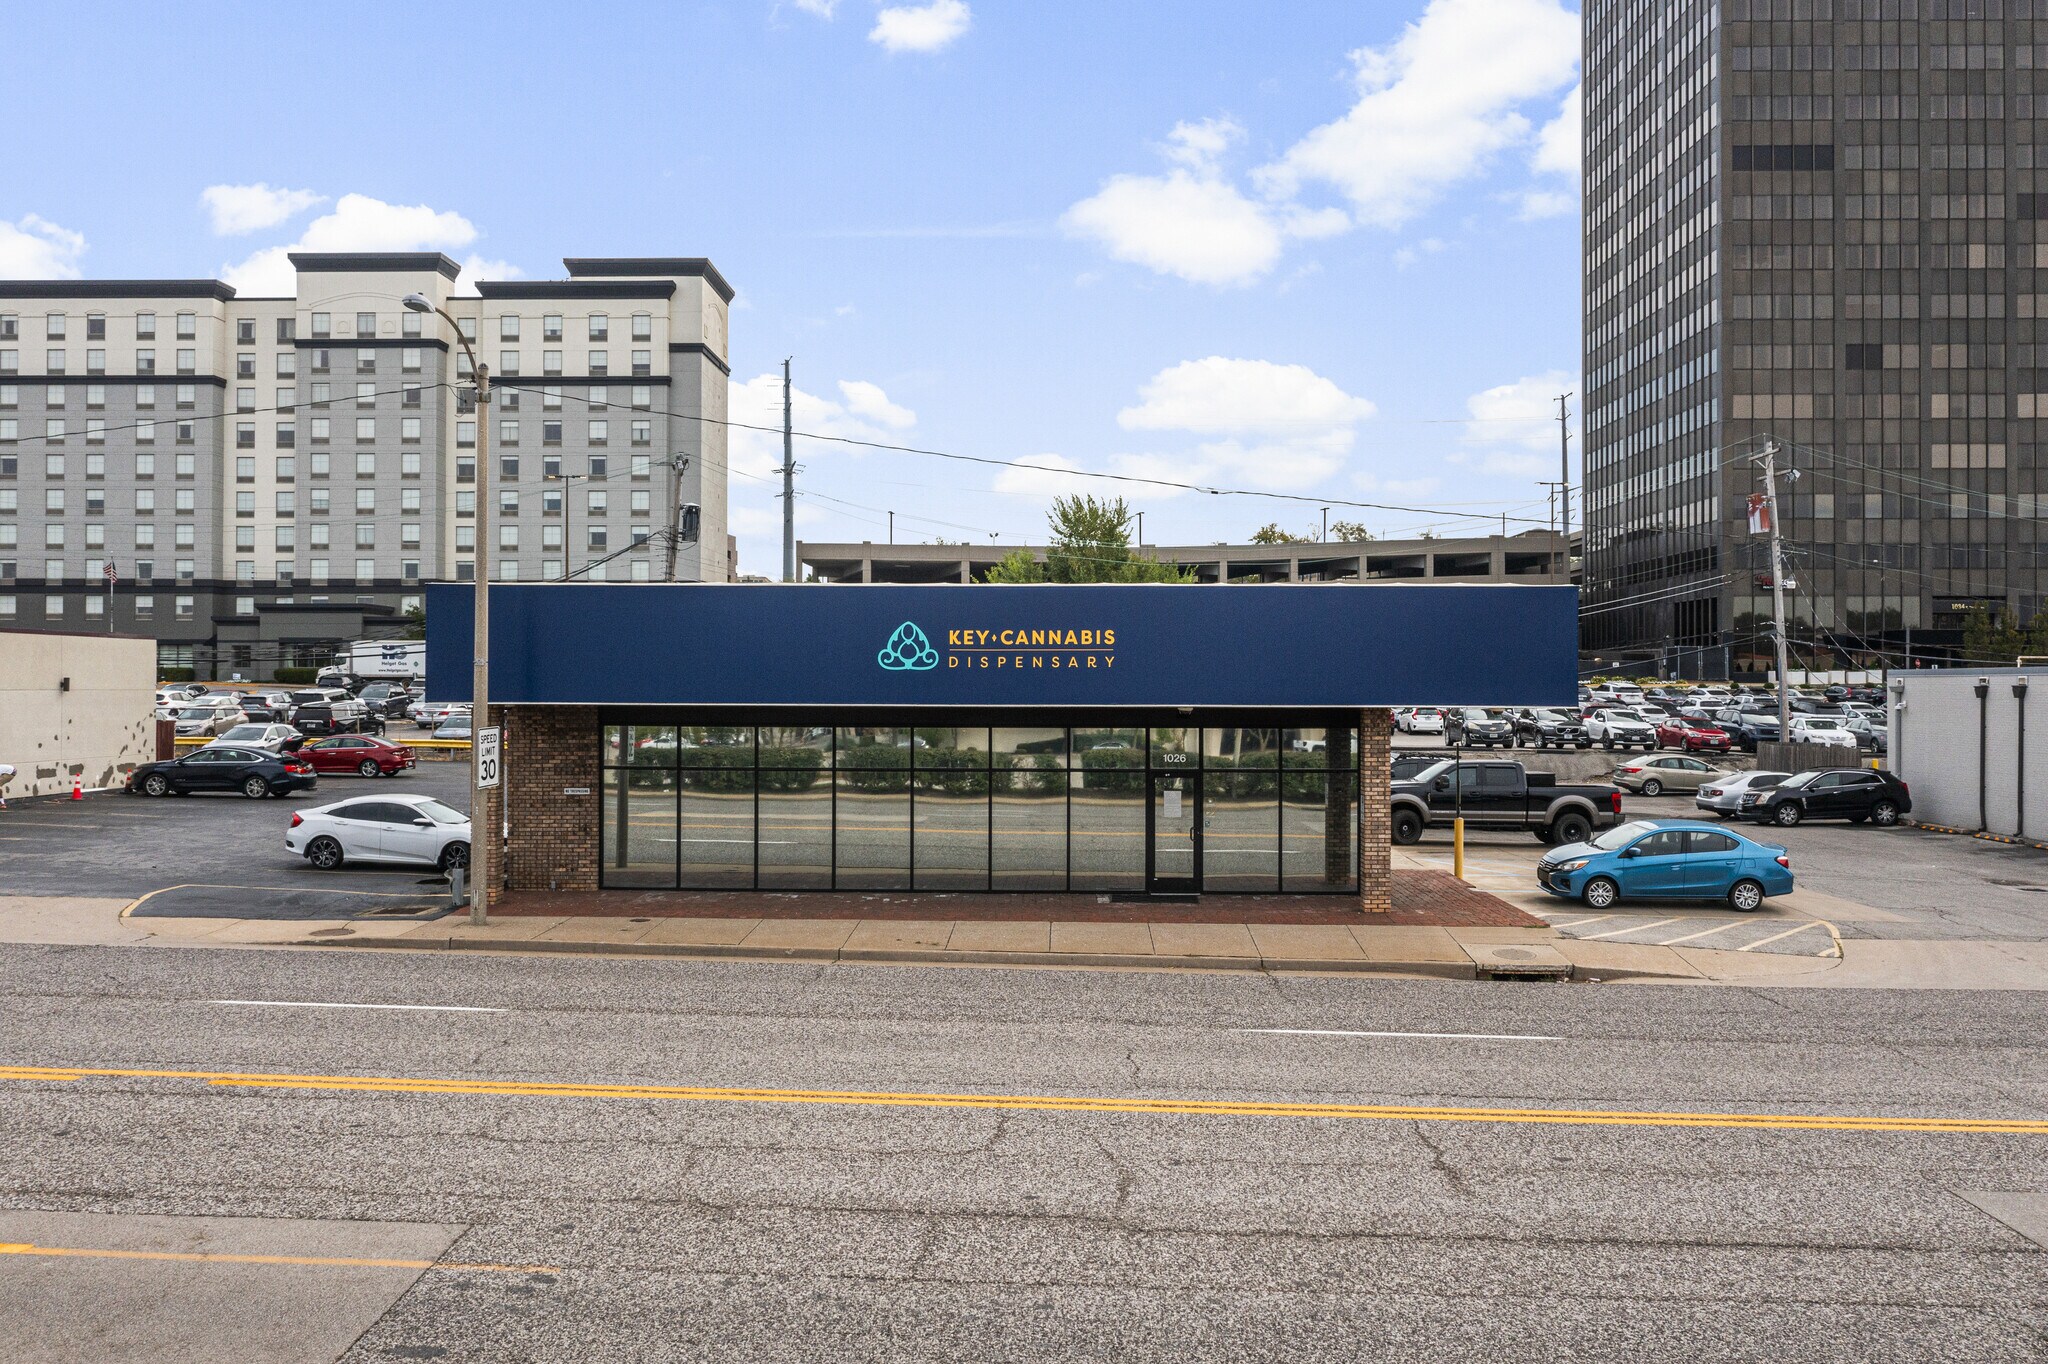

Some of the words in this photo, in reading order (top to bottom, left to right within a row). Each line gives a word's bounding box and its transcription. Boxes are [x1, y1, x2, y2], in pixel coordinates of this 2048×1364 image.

[949, 630, 990, 645] KEY
[1000, 629, 1116, 645] CANNABIS
[948, 656, 1115, 668] DISPENSARY
[480, 733, 498, 745] SPEED
[481, 746, 496, 757] LIMIT
[1163, 754, 1186, 762] 1026
[481, 759, 497, 781] 30
